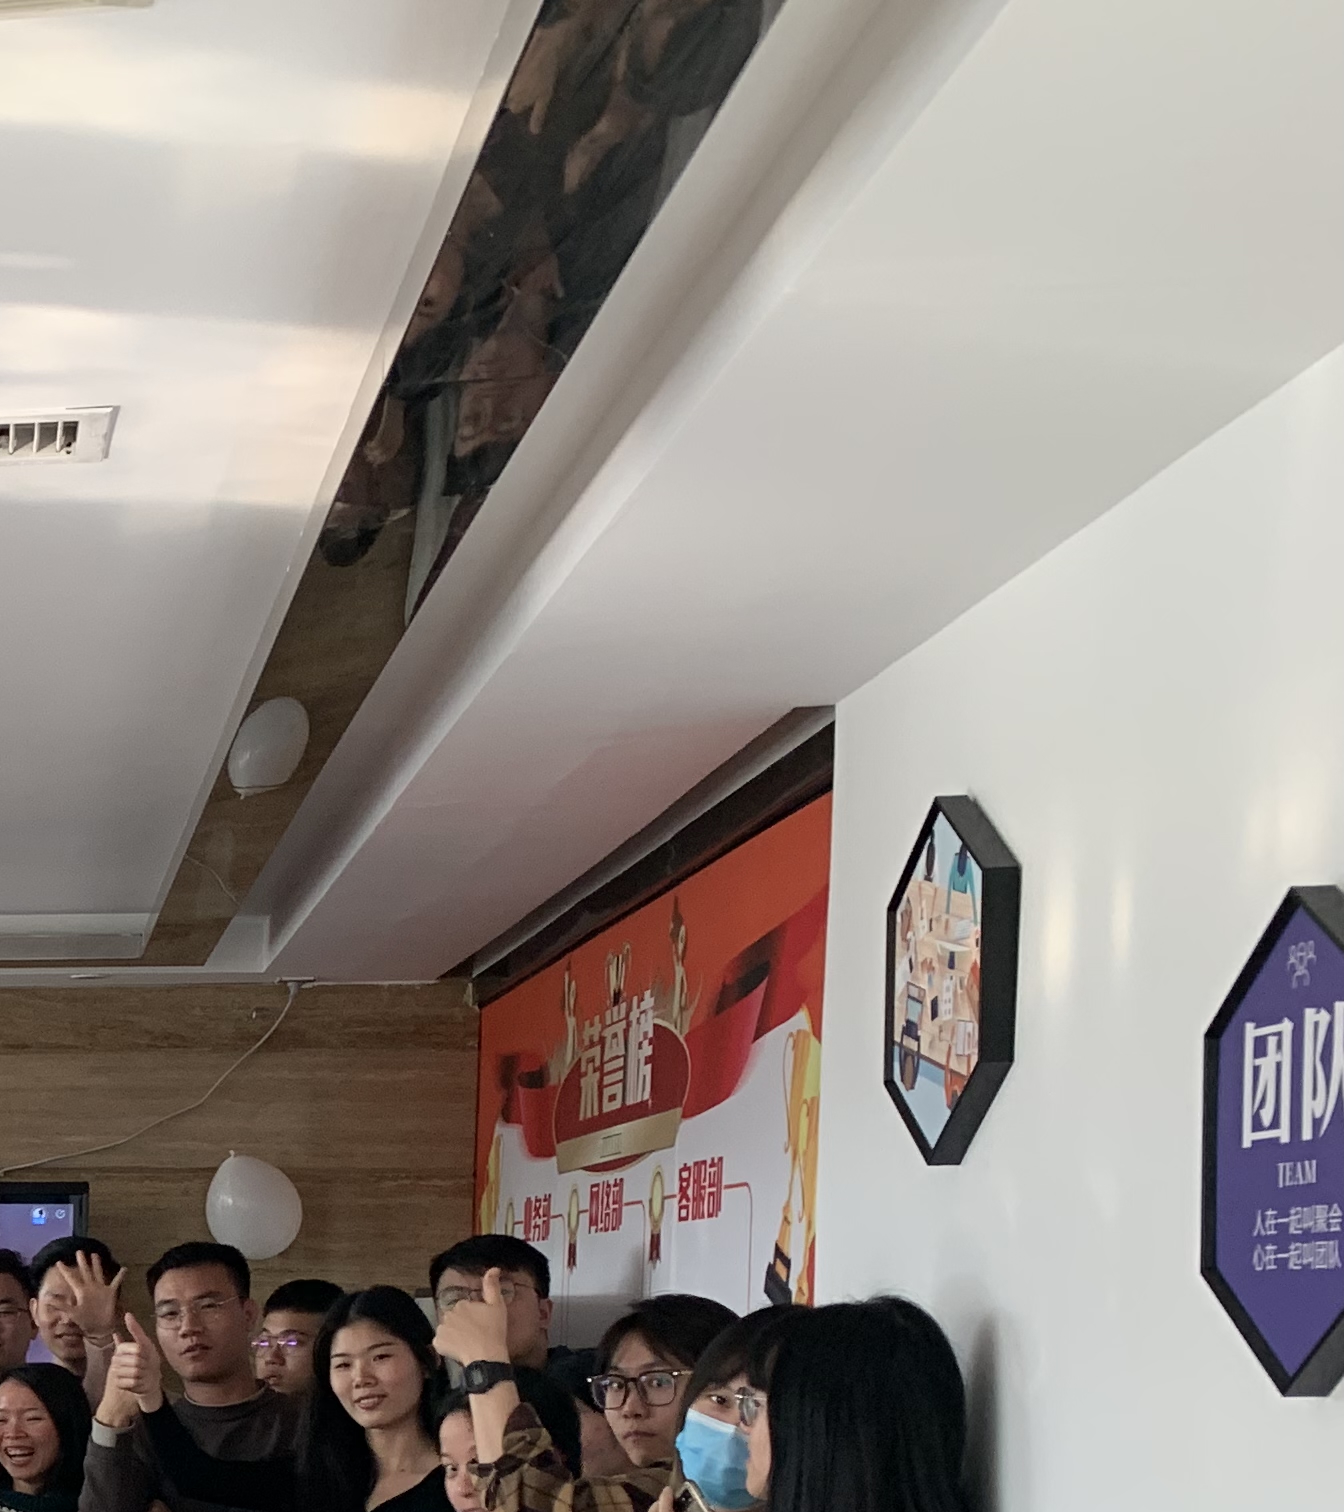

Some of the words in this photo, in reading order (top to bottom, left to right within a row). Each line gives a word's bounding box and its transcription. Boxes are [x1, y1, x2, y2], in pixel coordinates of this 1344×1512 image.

[579, 989, 654, 1121] 荣誉榜
[1242, 1001, 1344, 1148] 团队
[678, 1156, 724, 1222] 客服部
[1277, 1160, 1317, 1188] TEAM
[588, 1177, 624, 1234] 网络部
[1253, 1240, 1342, 1272] 心在一起叫团队
